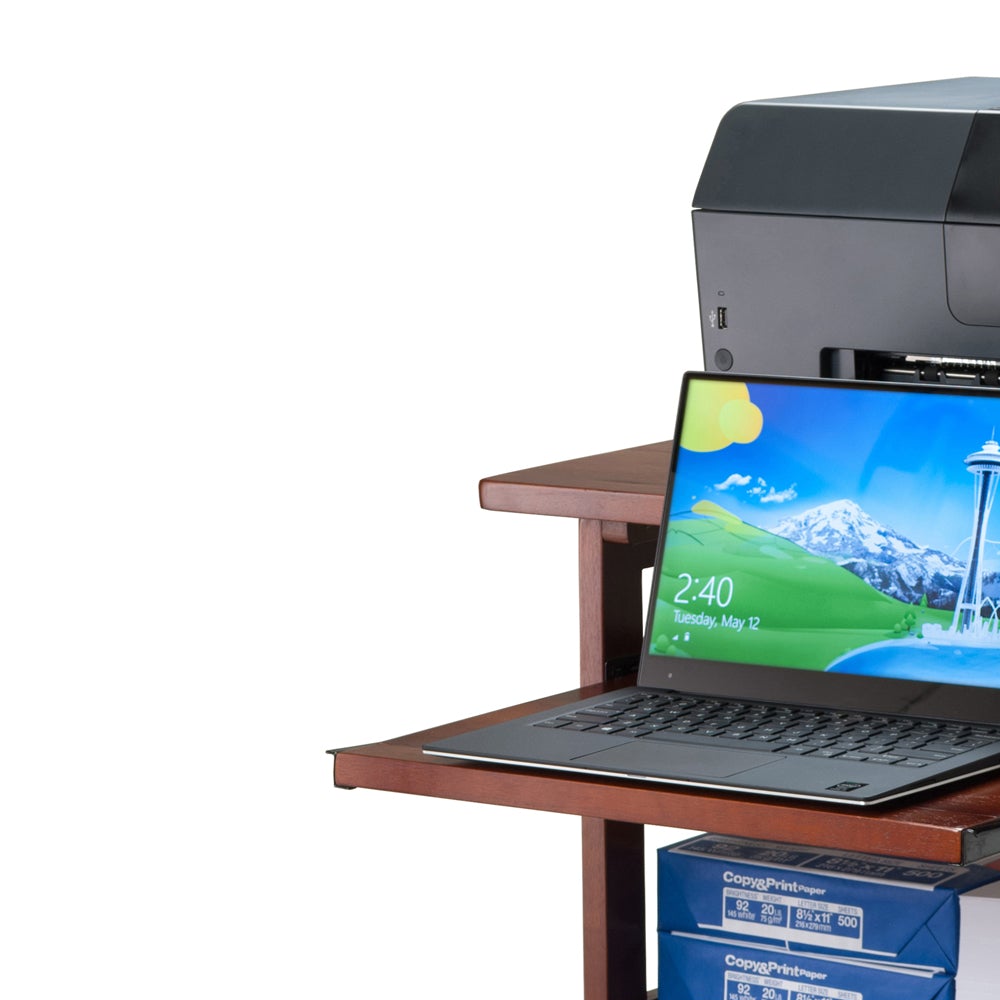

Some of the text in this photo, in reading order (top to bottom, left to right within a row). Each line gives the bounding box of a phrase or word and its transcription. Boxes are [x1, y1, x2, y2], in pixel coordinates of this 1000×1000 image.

[673, 572, 734, 608] 2:40
[673, 609, 760, 632] Tuesday, May 12
[736, 899, 749, 912] 92
[761, 904, 775, 916] 20
[837, 916, 858, 928] 500
[737, 983, 750, 996] 92
[762, 987, 775, 1000] 20
